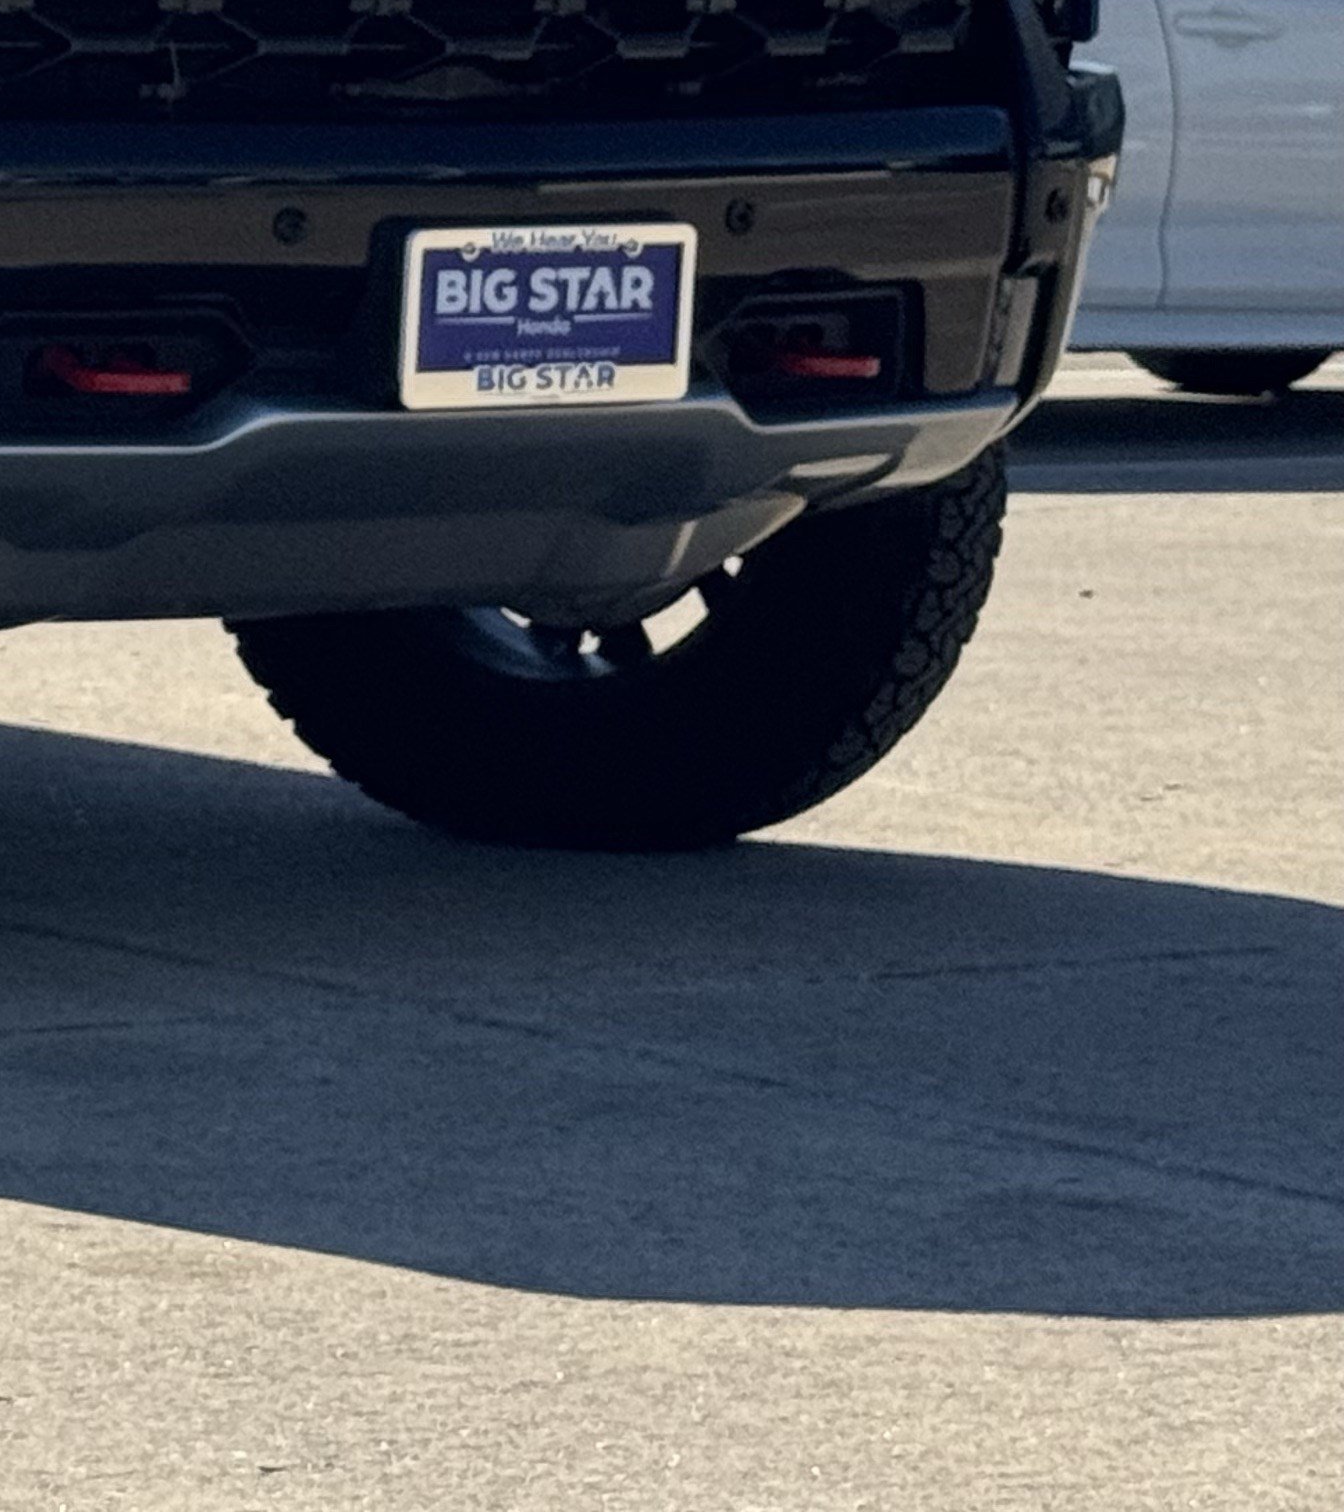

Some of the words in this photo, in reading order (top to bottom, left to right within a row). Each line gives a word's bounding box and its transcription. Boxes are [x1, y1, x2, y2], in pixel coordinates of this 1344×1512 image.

[436, 267, 519, 314] BIG
[528, 264, 655, 313] STAR
[477, 366, 527, 392] BIG
[535, 363, 616, 390] STAR
